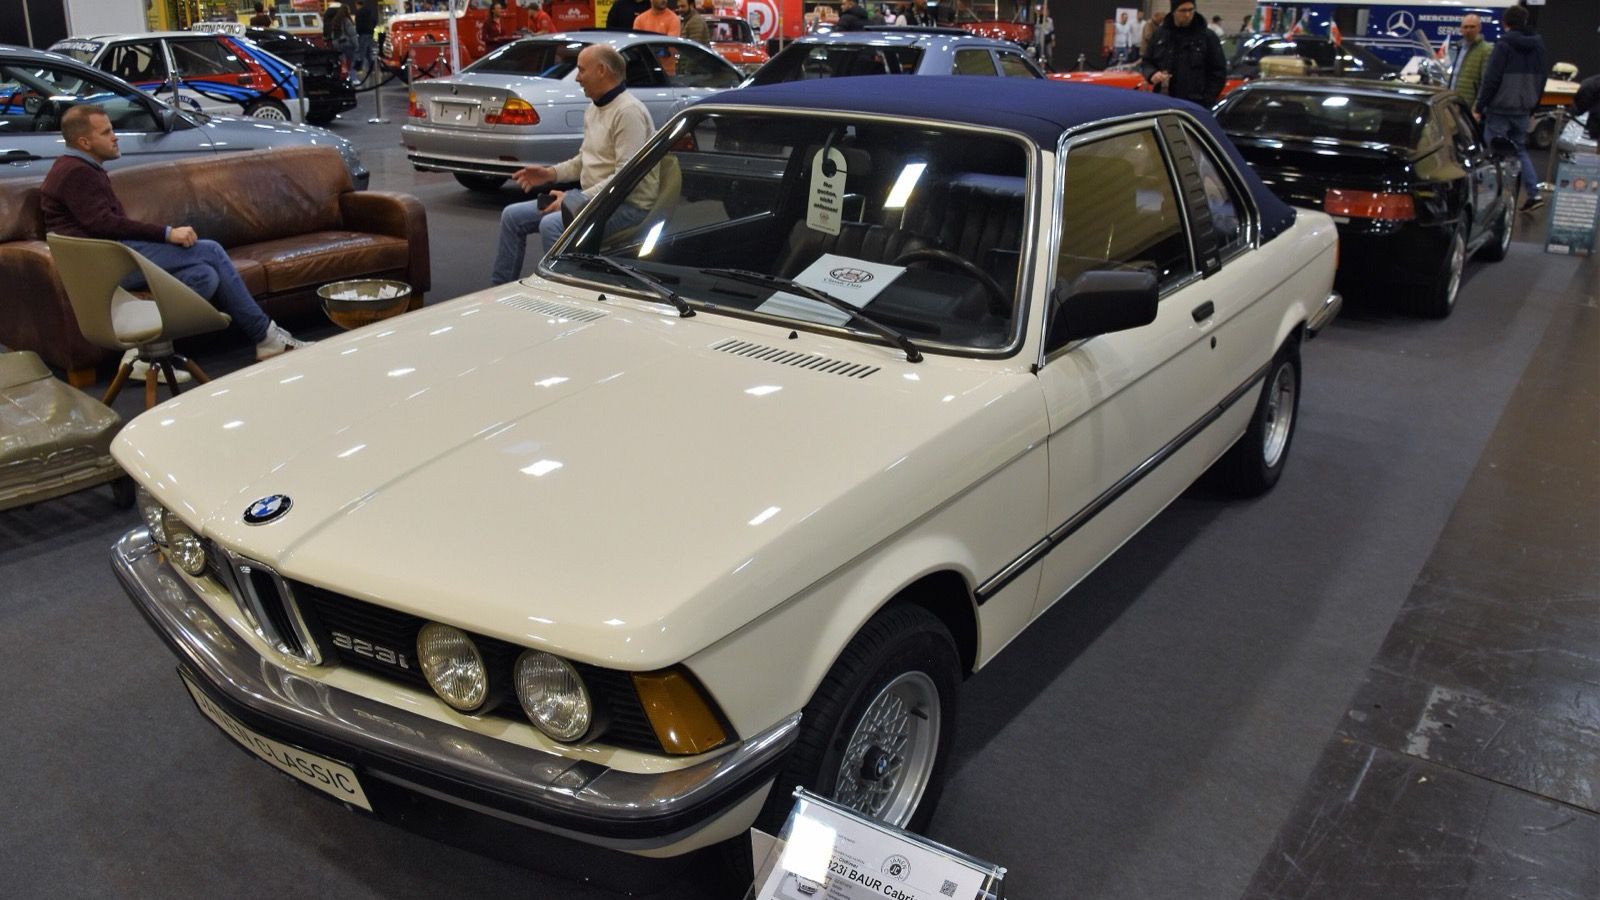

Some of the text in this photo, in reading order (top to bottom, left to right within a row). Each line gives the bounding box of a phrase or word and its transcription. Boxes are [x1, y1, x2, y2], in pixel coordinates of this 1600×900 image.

[331, 631, 409, 669] 323i
[254, 737, 355, 794] CLASSIC
[848, 869, 882, 891] BAUR
